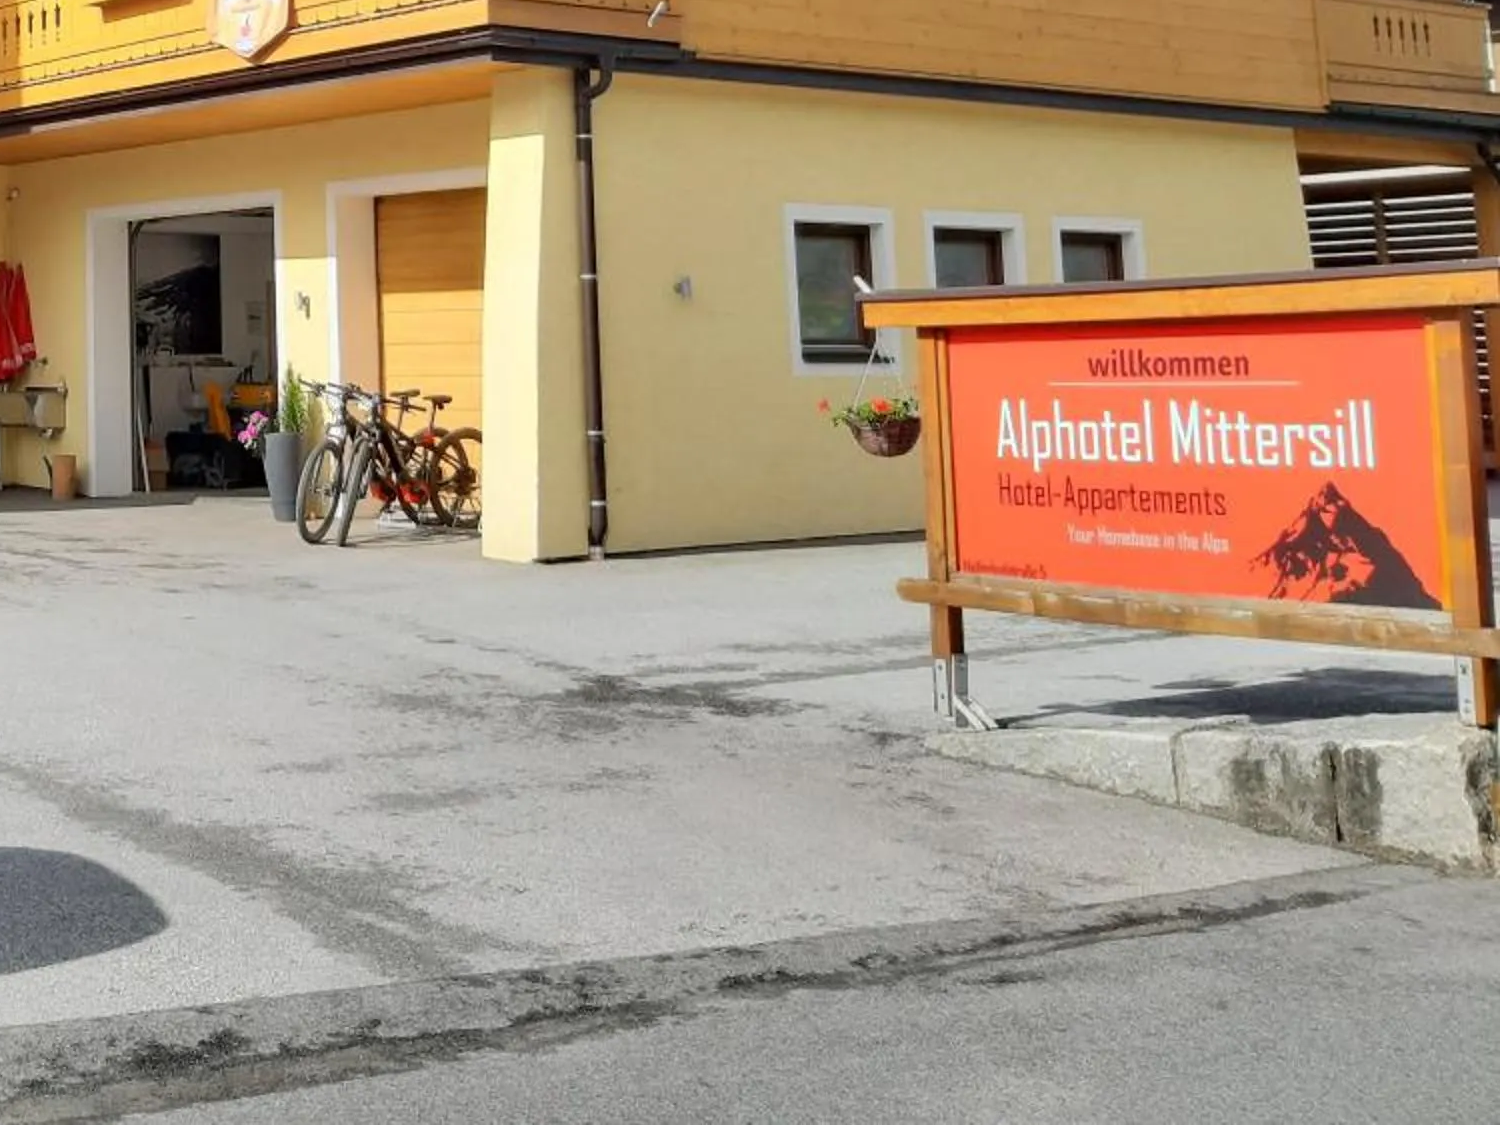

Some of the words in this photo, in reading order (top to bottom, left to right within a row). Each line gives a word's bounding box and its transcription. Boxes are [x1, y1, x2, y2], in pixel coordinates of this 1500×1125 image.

[1087, 349, 1250, 378] willkommen
[997, 397, 1155, 472] Alphotel
[1169, 399, 1376, 470] Mittersill
[998, 473, 1227, 517] Hotel-Appartements
